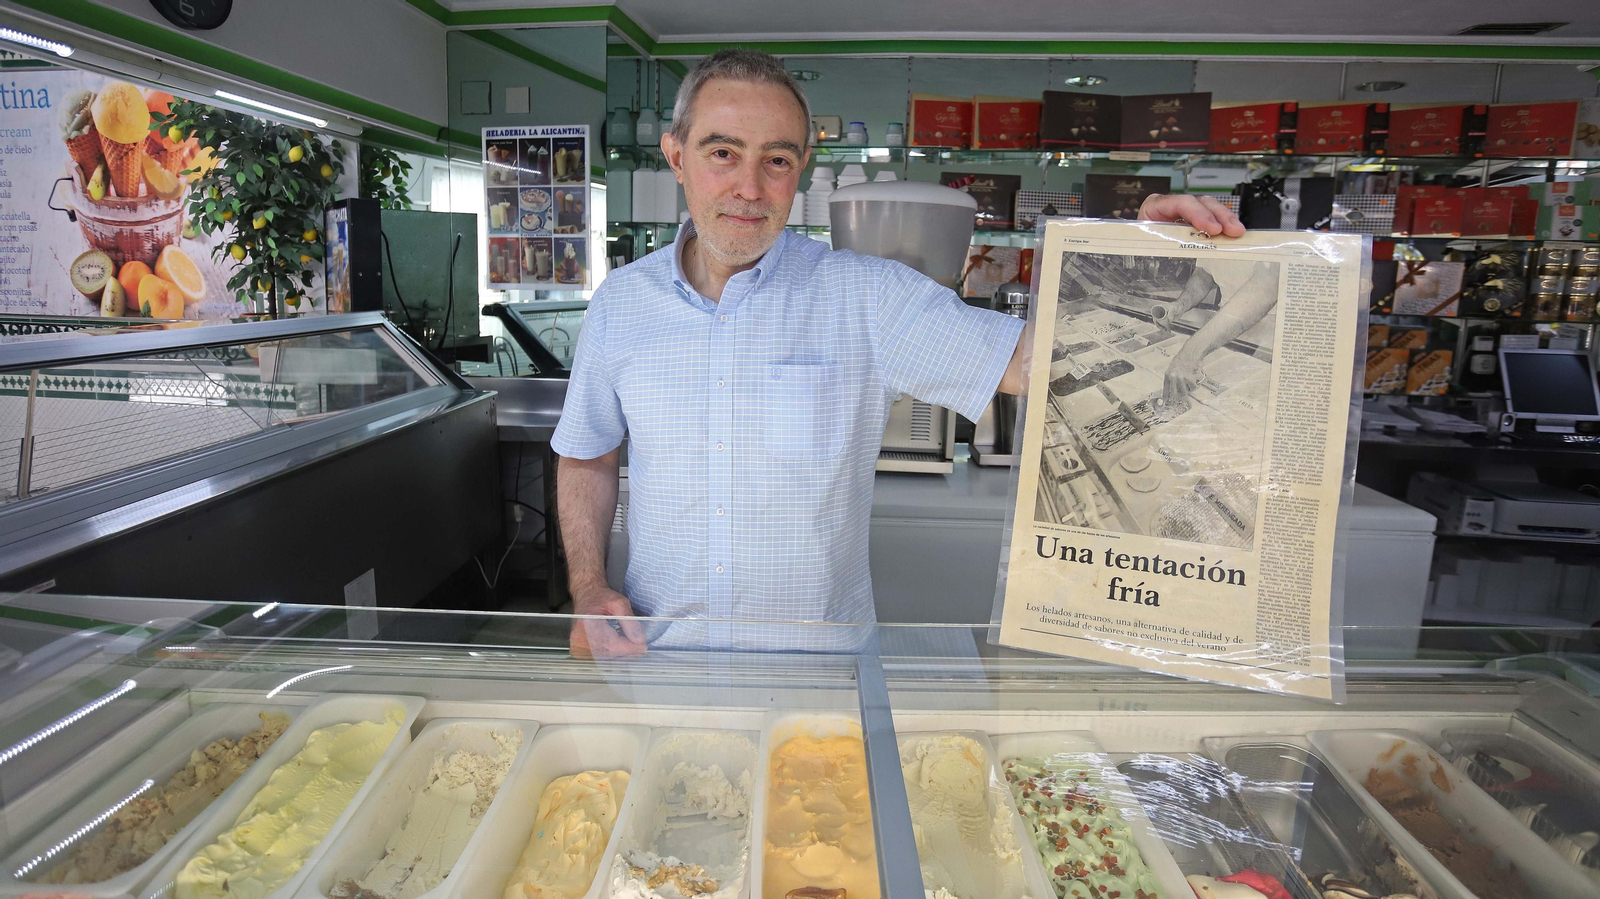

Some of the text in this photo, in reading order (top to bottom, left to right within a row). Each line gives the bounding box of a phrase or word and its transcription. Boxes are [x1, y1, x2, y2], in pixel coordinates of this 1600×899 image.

[0, 82, 52, 110] tina
[5, 145, 13, 154] de
[15, 145, 32, 154] cielo
[19, 225, 37, 233] pasas
[19, 298, 27, 306] de
[1215, 499, 1246, 531] MERENGADA
[1036, 535, 1246, 586] Una tentación
[1107, 577, 1160, 606] fría
[1026, 603, 1040, 612] Los
[1042, 605, 1071, 617] helados
[1074, 613, 1113, 624] artesanos,
[1134, 620, 1176, 634] alternativa
[1179, 627, 1189, 635] de
[1192, 630, 1222, 641] calidad
[1233, 636, 1243, 644] de
[1040, 615, 1079, 628] diversidad
[1094, 625, 1124, 635] sabores
[1140, 633, 1178, 644] exclusiva
[1181, 638, 1194, 646] del
[1197, 642, 1226, 652] verano
